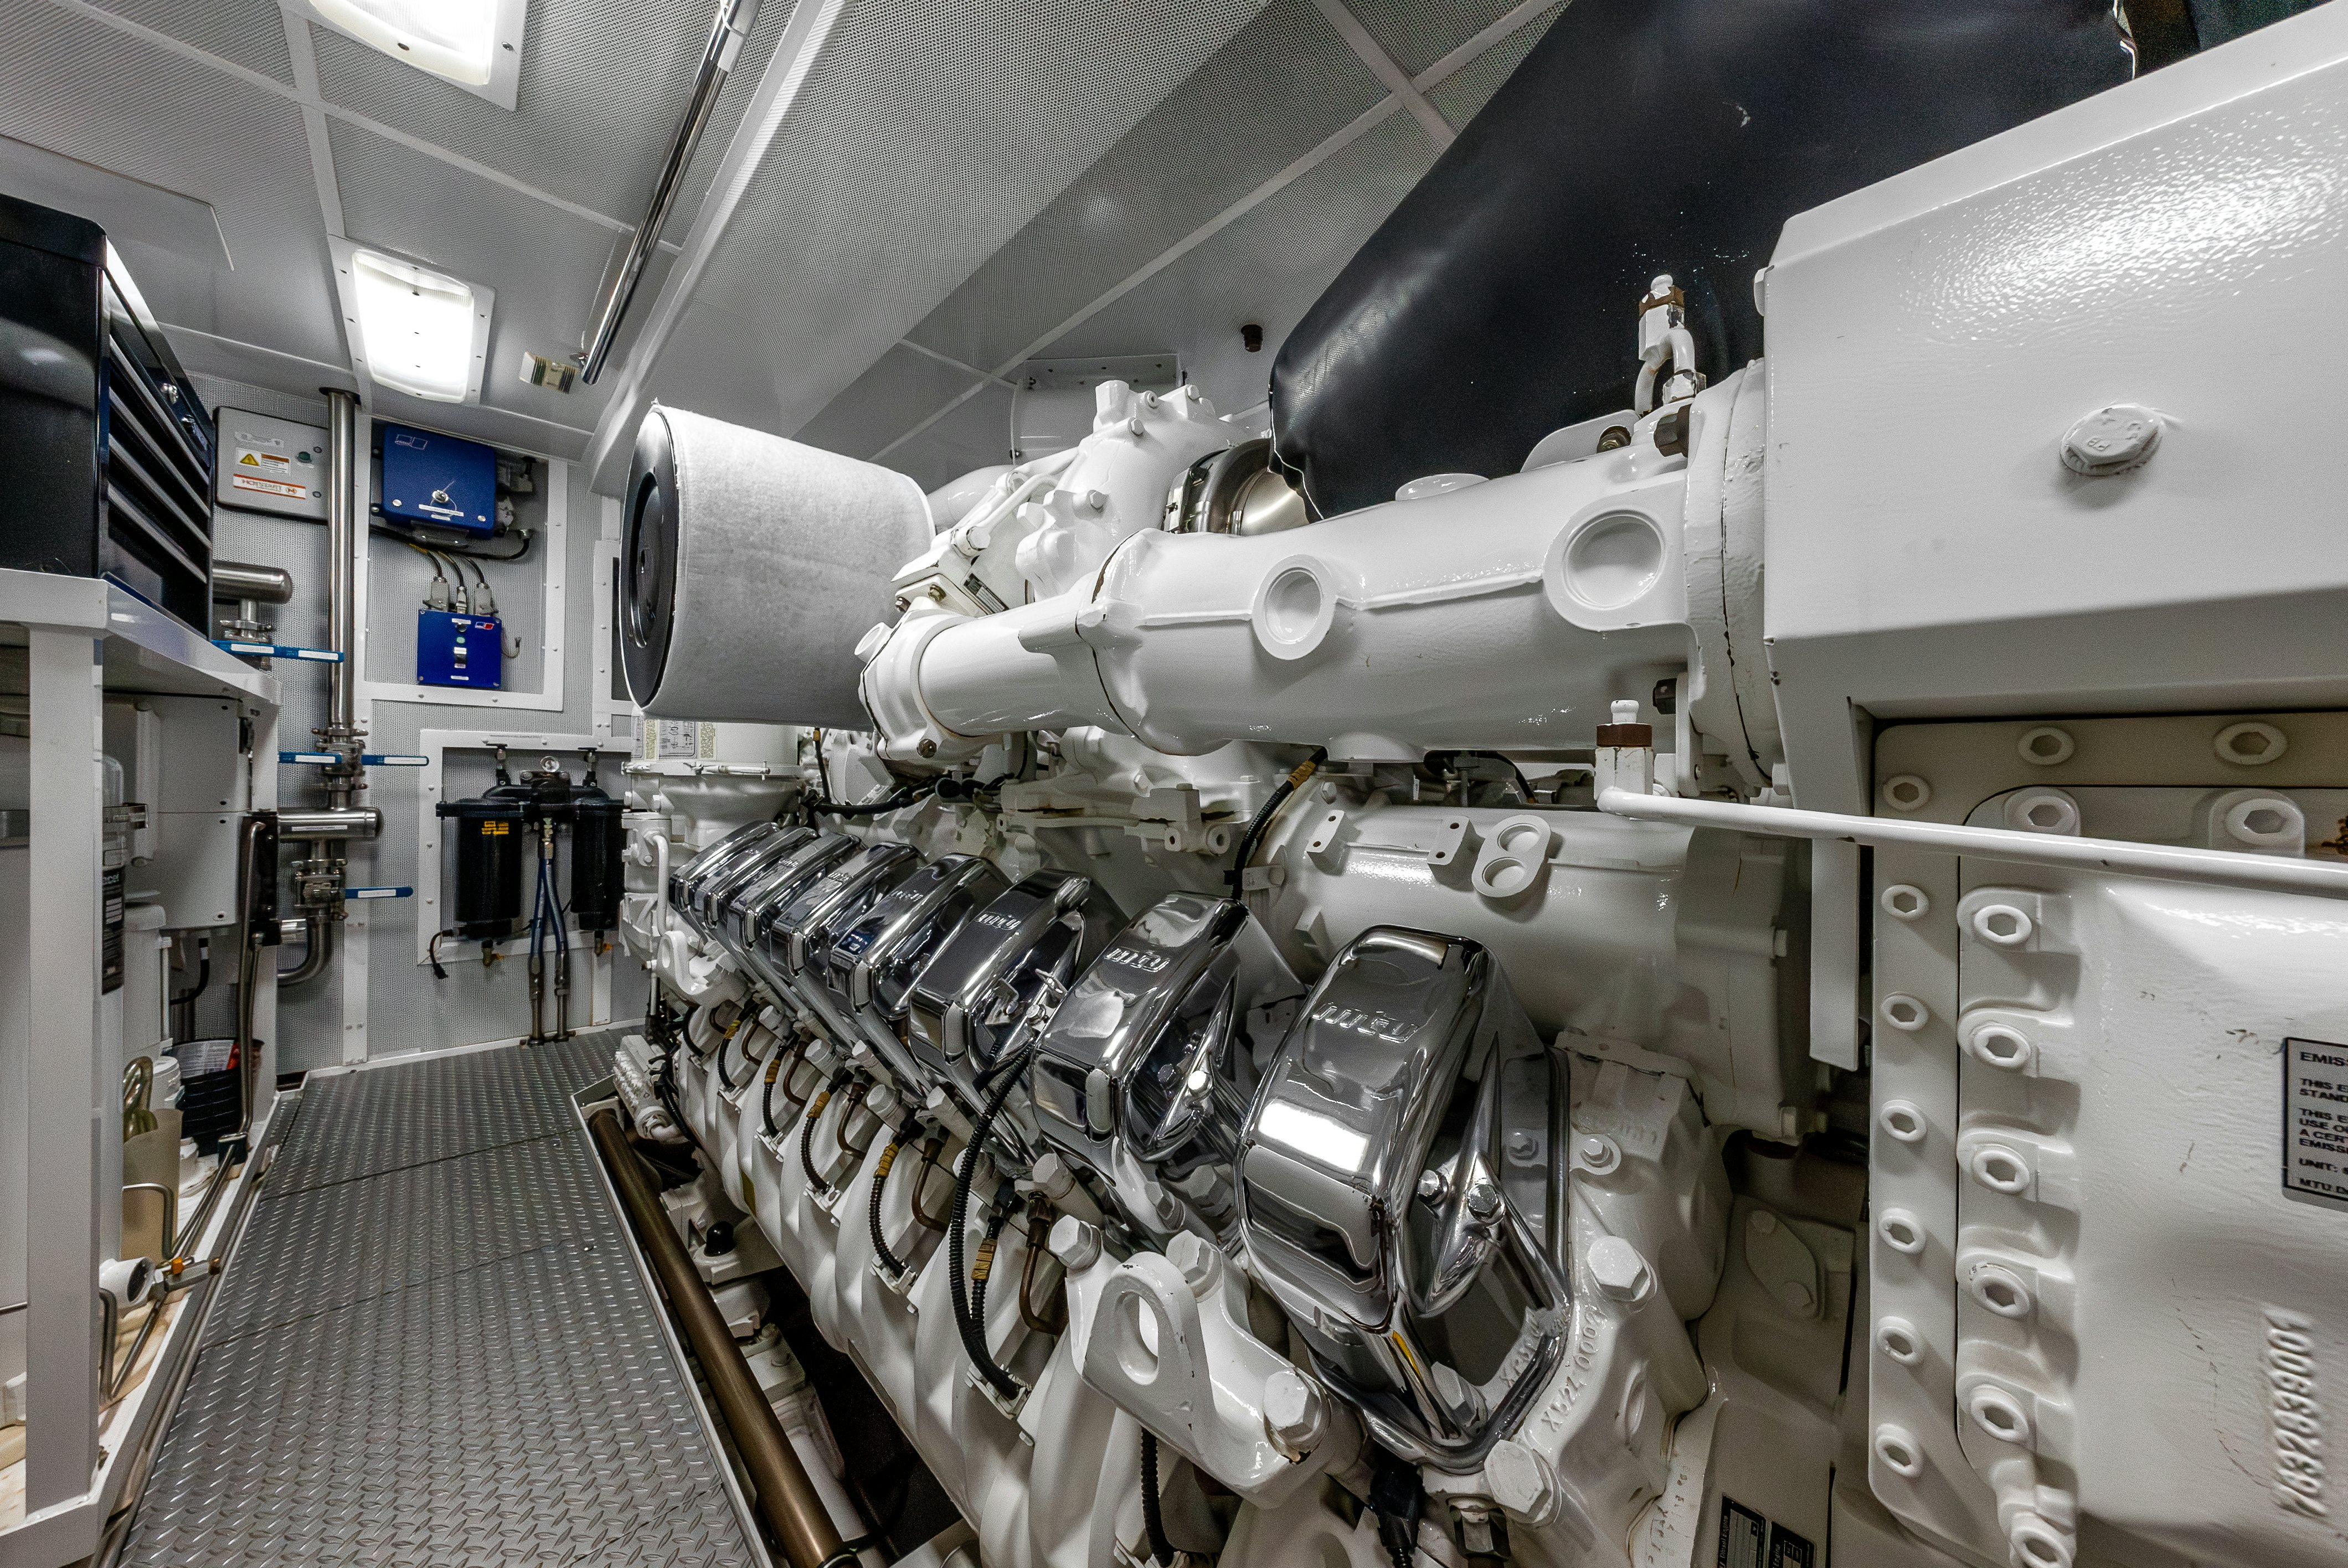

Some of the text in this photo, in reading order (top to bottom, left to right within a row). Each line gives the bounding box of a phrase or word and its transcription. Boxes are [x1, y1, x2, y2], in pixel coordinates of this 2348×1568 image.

[1104, 947, 1171, 973] mtu
[1311, 1001, 1422, 1044] mtu
[2300, 1051, 2348, 1067] EMIS
[2299, 1077, 2333, 1090] THIS
[2299, 1107, 2332, 1121] THIS
[2299, 1117, 2348, 1133] USE O
[2299, 1128, 2310, 1137] A
[2299, 1178, 2332, 1191] MTU
